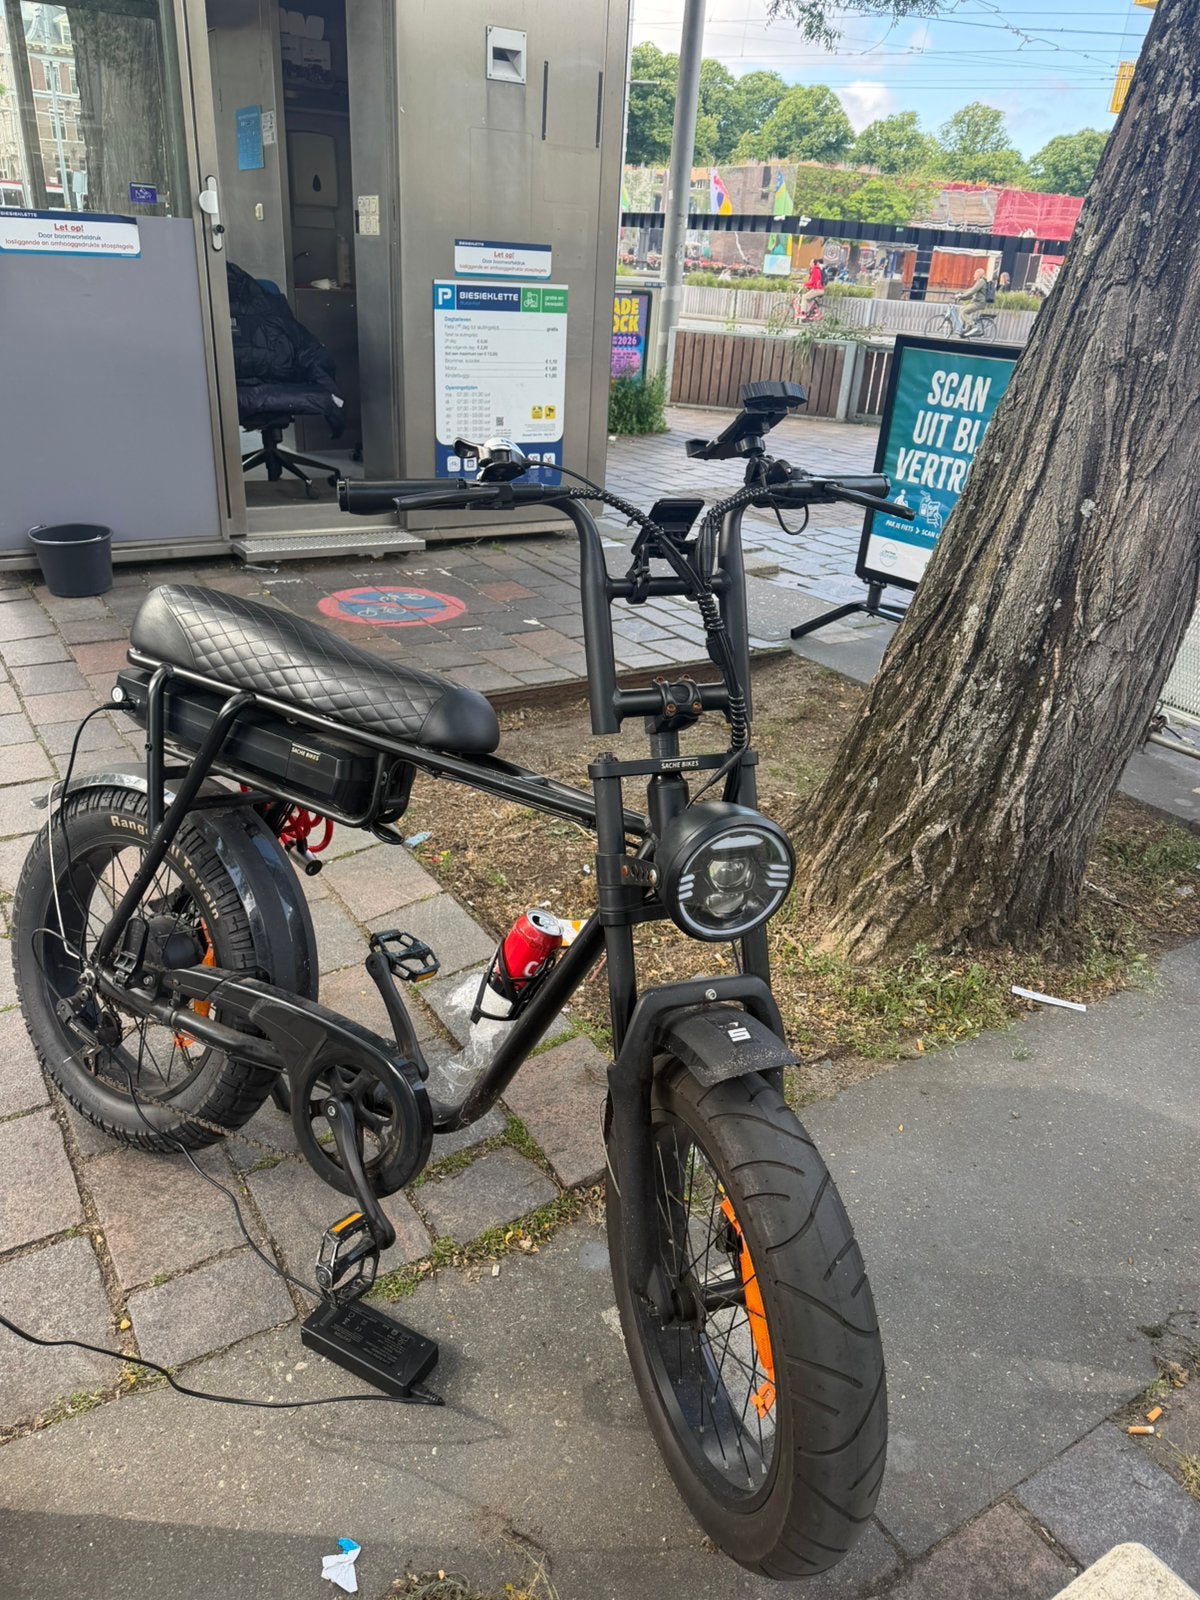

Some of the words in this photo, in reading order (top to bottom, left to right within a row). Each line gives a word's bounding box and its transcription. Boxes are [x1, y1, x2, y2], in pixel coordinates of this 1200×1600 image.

[54, 223, 68, 231] Let
[438, 287, 452, 305] P
[459, 291, 519, 301] BIESIEKLETTE
[617, 336, 637, 345] 2026
[927, 370, 992, 413] SCAN
[912, 410, 954, 448] UIT
[952, 417, 990, 457] BI
[895, 447, 974, 494] VERTR
[921, 529, 936, 538] SCAN
[661, 761, 681, 769] SACHE
[110, 815, 149, 835] Rang
